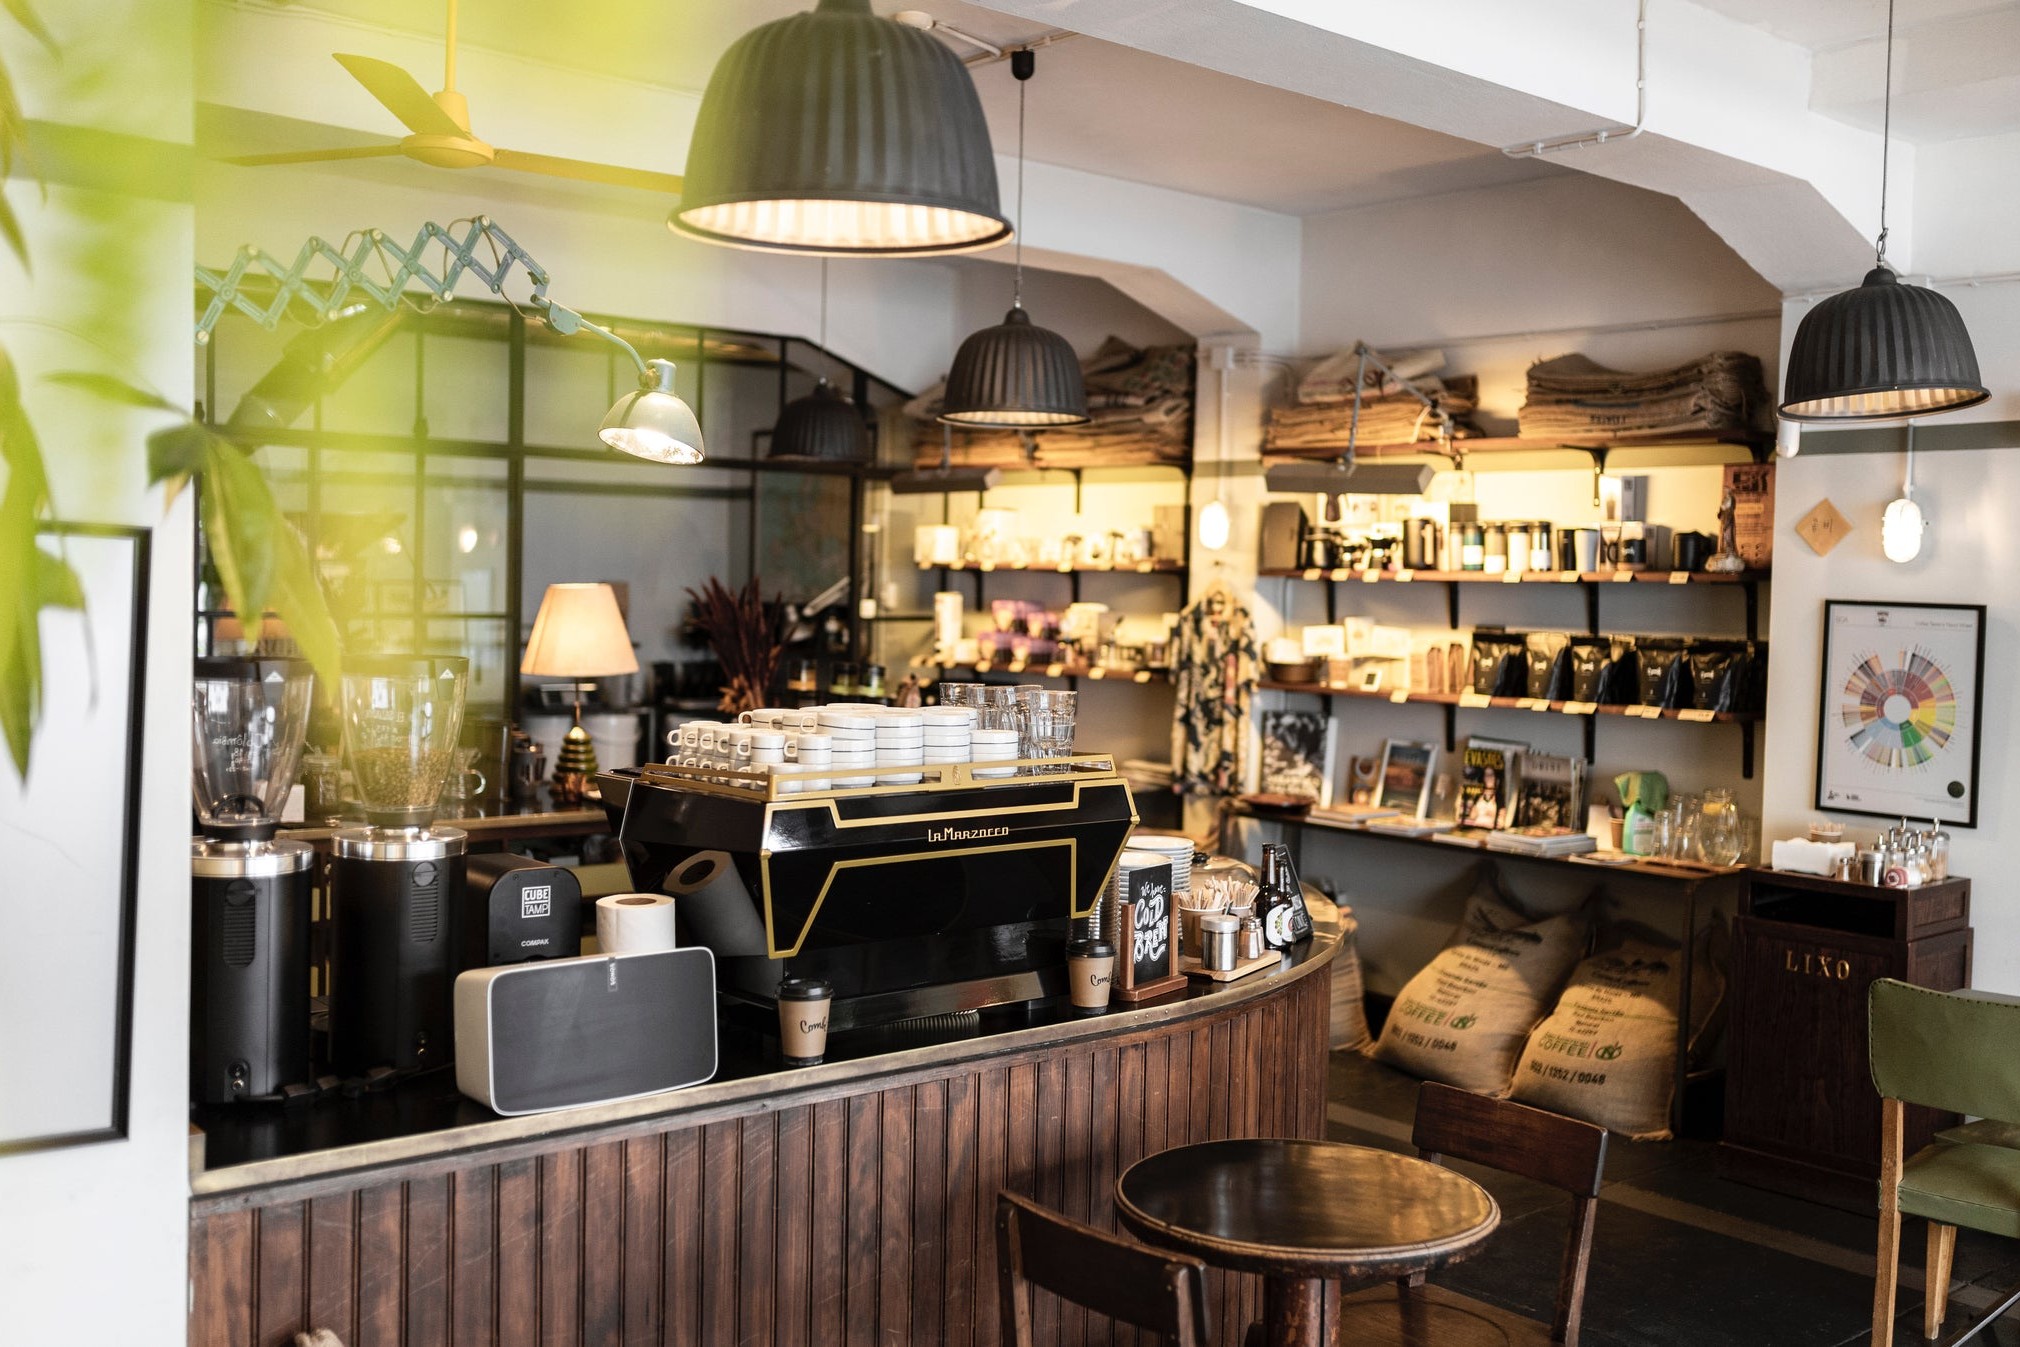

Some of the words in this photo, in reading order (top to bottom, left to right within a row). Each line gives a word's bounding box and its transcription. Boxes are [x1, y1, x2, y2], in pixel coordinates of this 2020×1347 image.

[524, 888, 549, 901] CUBE
[524, 903, 549, 915] TAMP
[520, 938, 550, 947] COMPAK
[1786, 950, 1850, 980] LIXO
